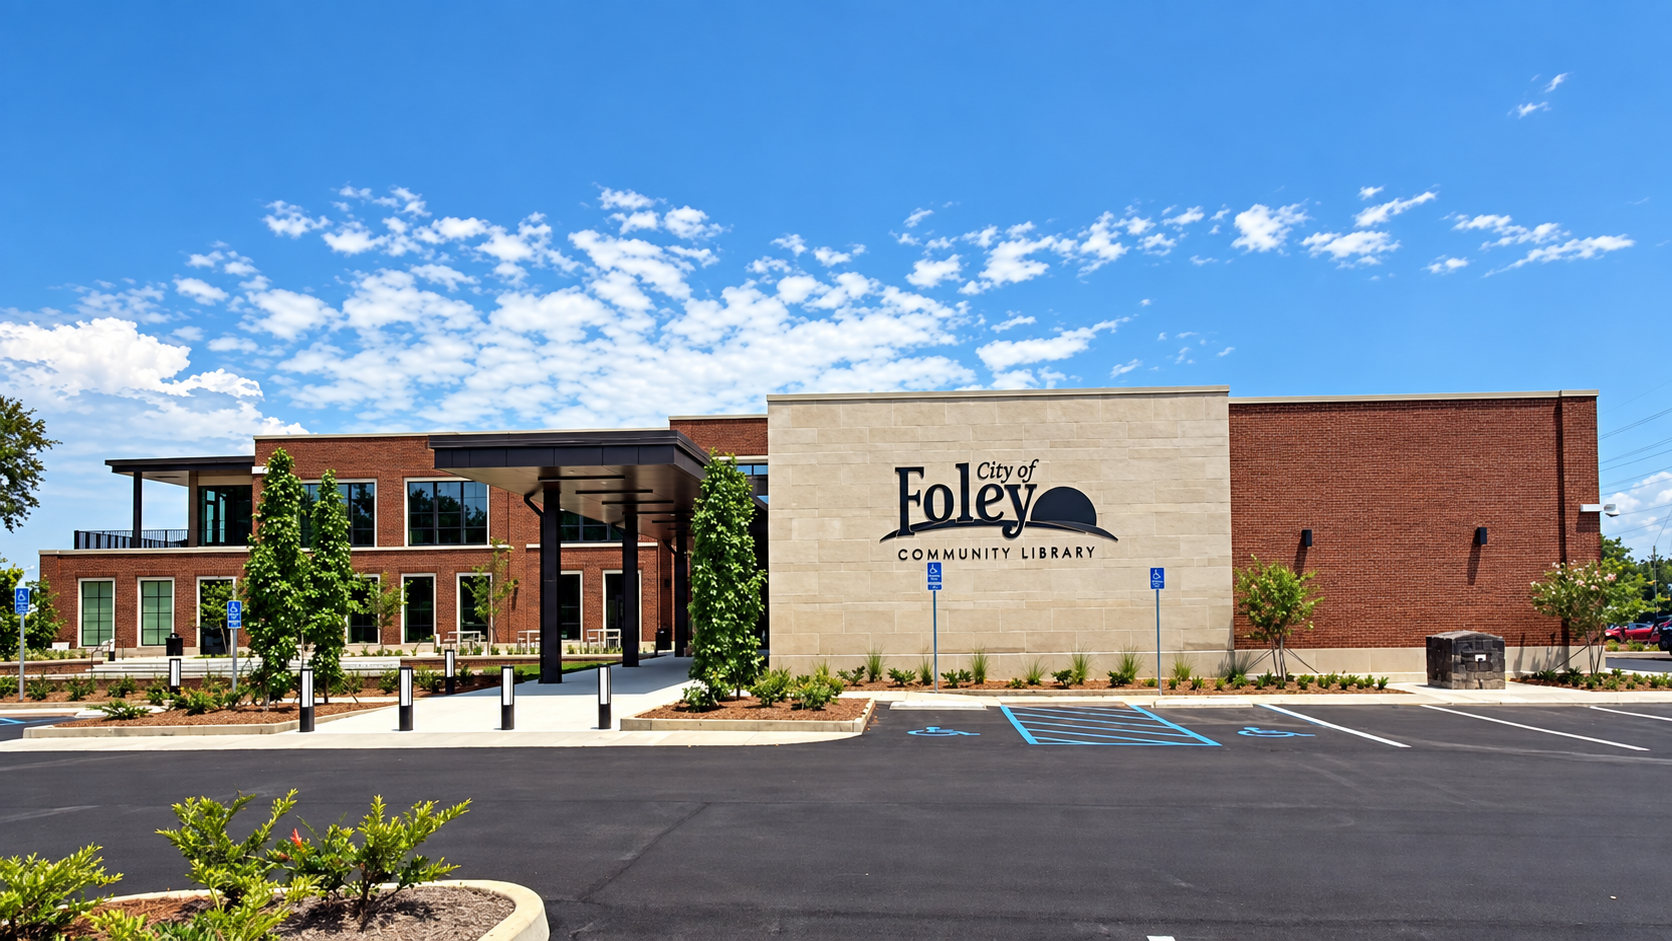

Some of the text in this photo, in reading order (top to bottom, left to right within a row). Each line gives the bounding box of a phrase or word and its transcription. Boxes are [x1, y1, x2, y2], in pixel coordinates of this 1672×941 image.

[977, 459, 1039, 484] City of
[895, 463, 1037, 539] Foley
[897, 546, 1095, 561] COMMUNITY LIBRARY
